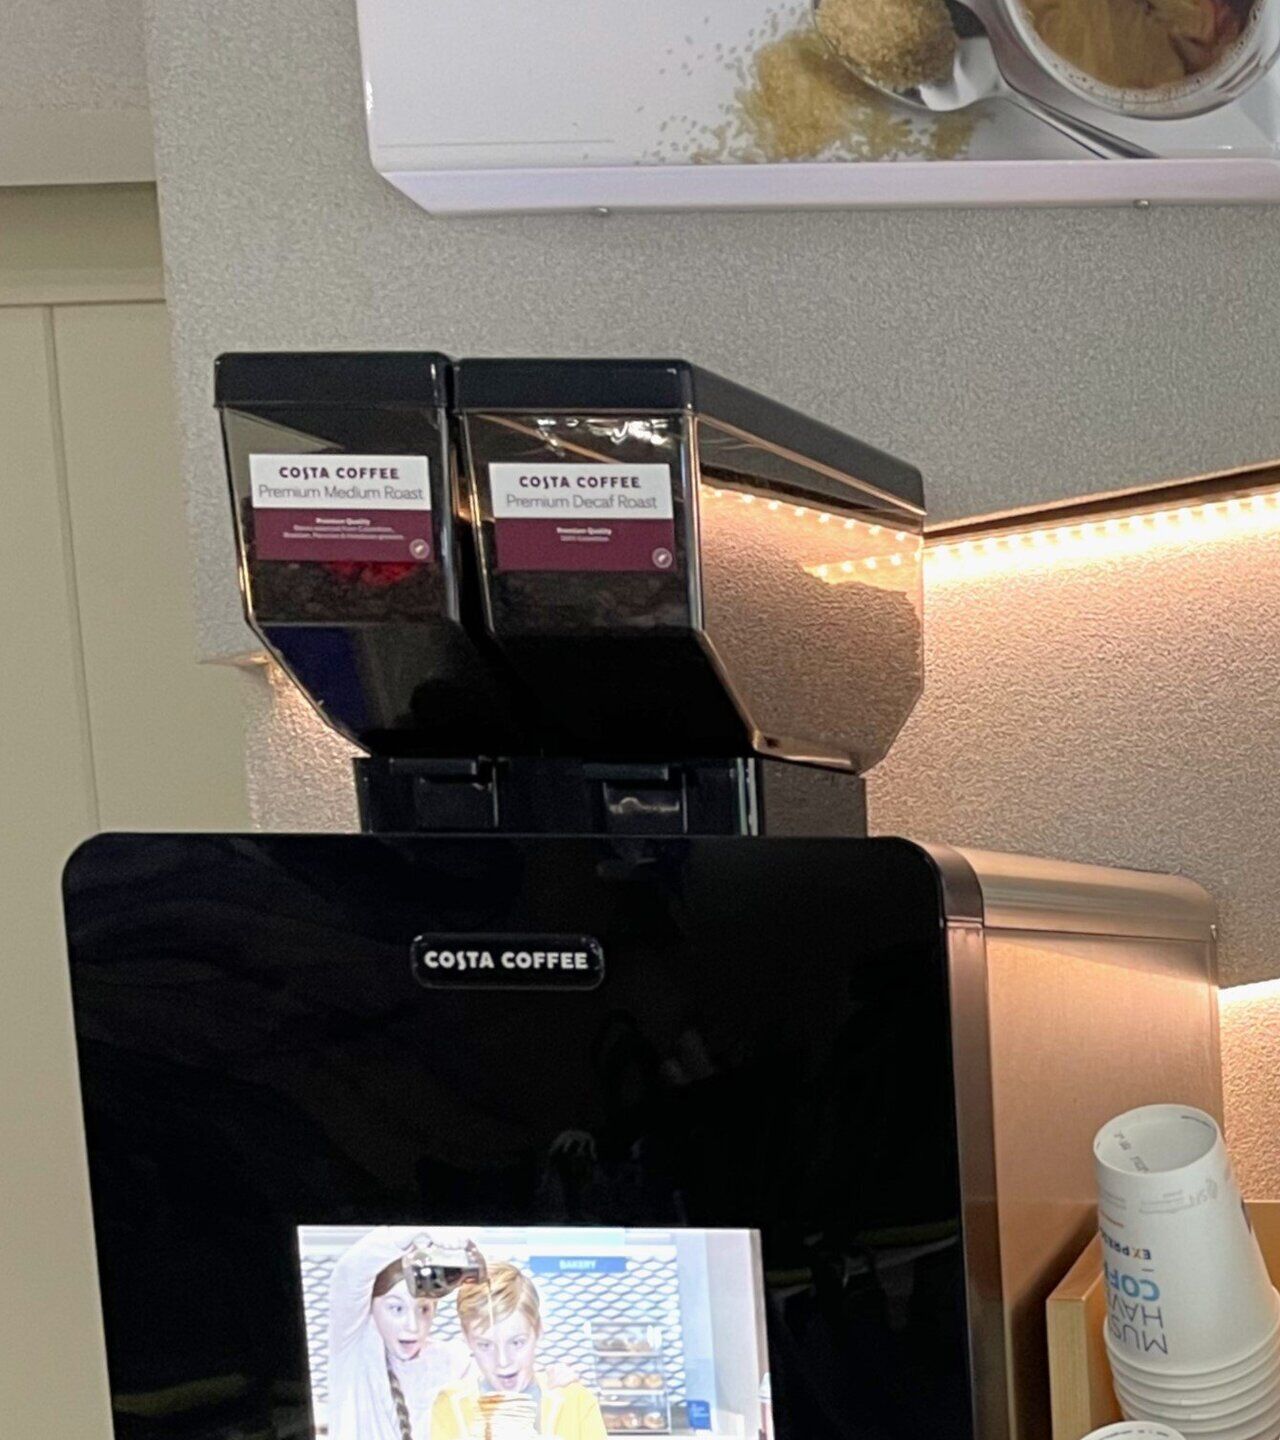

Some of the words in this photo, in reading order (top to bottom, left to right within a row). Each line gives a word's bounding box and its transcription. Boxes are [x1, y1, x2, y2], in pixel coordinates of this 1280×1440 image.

[279, 467, 329, 480] COSTA
[336, 467, 400, 479] COFFEE
[519, 476, 570, 489] COSTA
[577, 477, 641, 488] COFFEE
[258, 484, 321, 498] Premium
[324, 486, 380, 499] Medium
[384, 485, 423, 500] Roast
[506, 494, 570, 508] Premium
[573, 495, 616, 509] Decaf
[618, 495, 657, 509] Roast
[424, 951, 495, 970] COSTA
[501, 952, 588, 969] COFFEE
